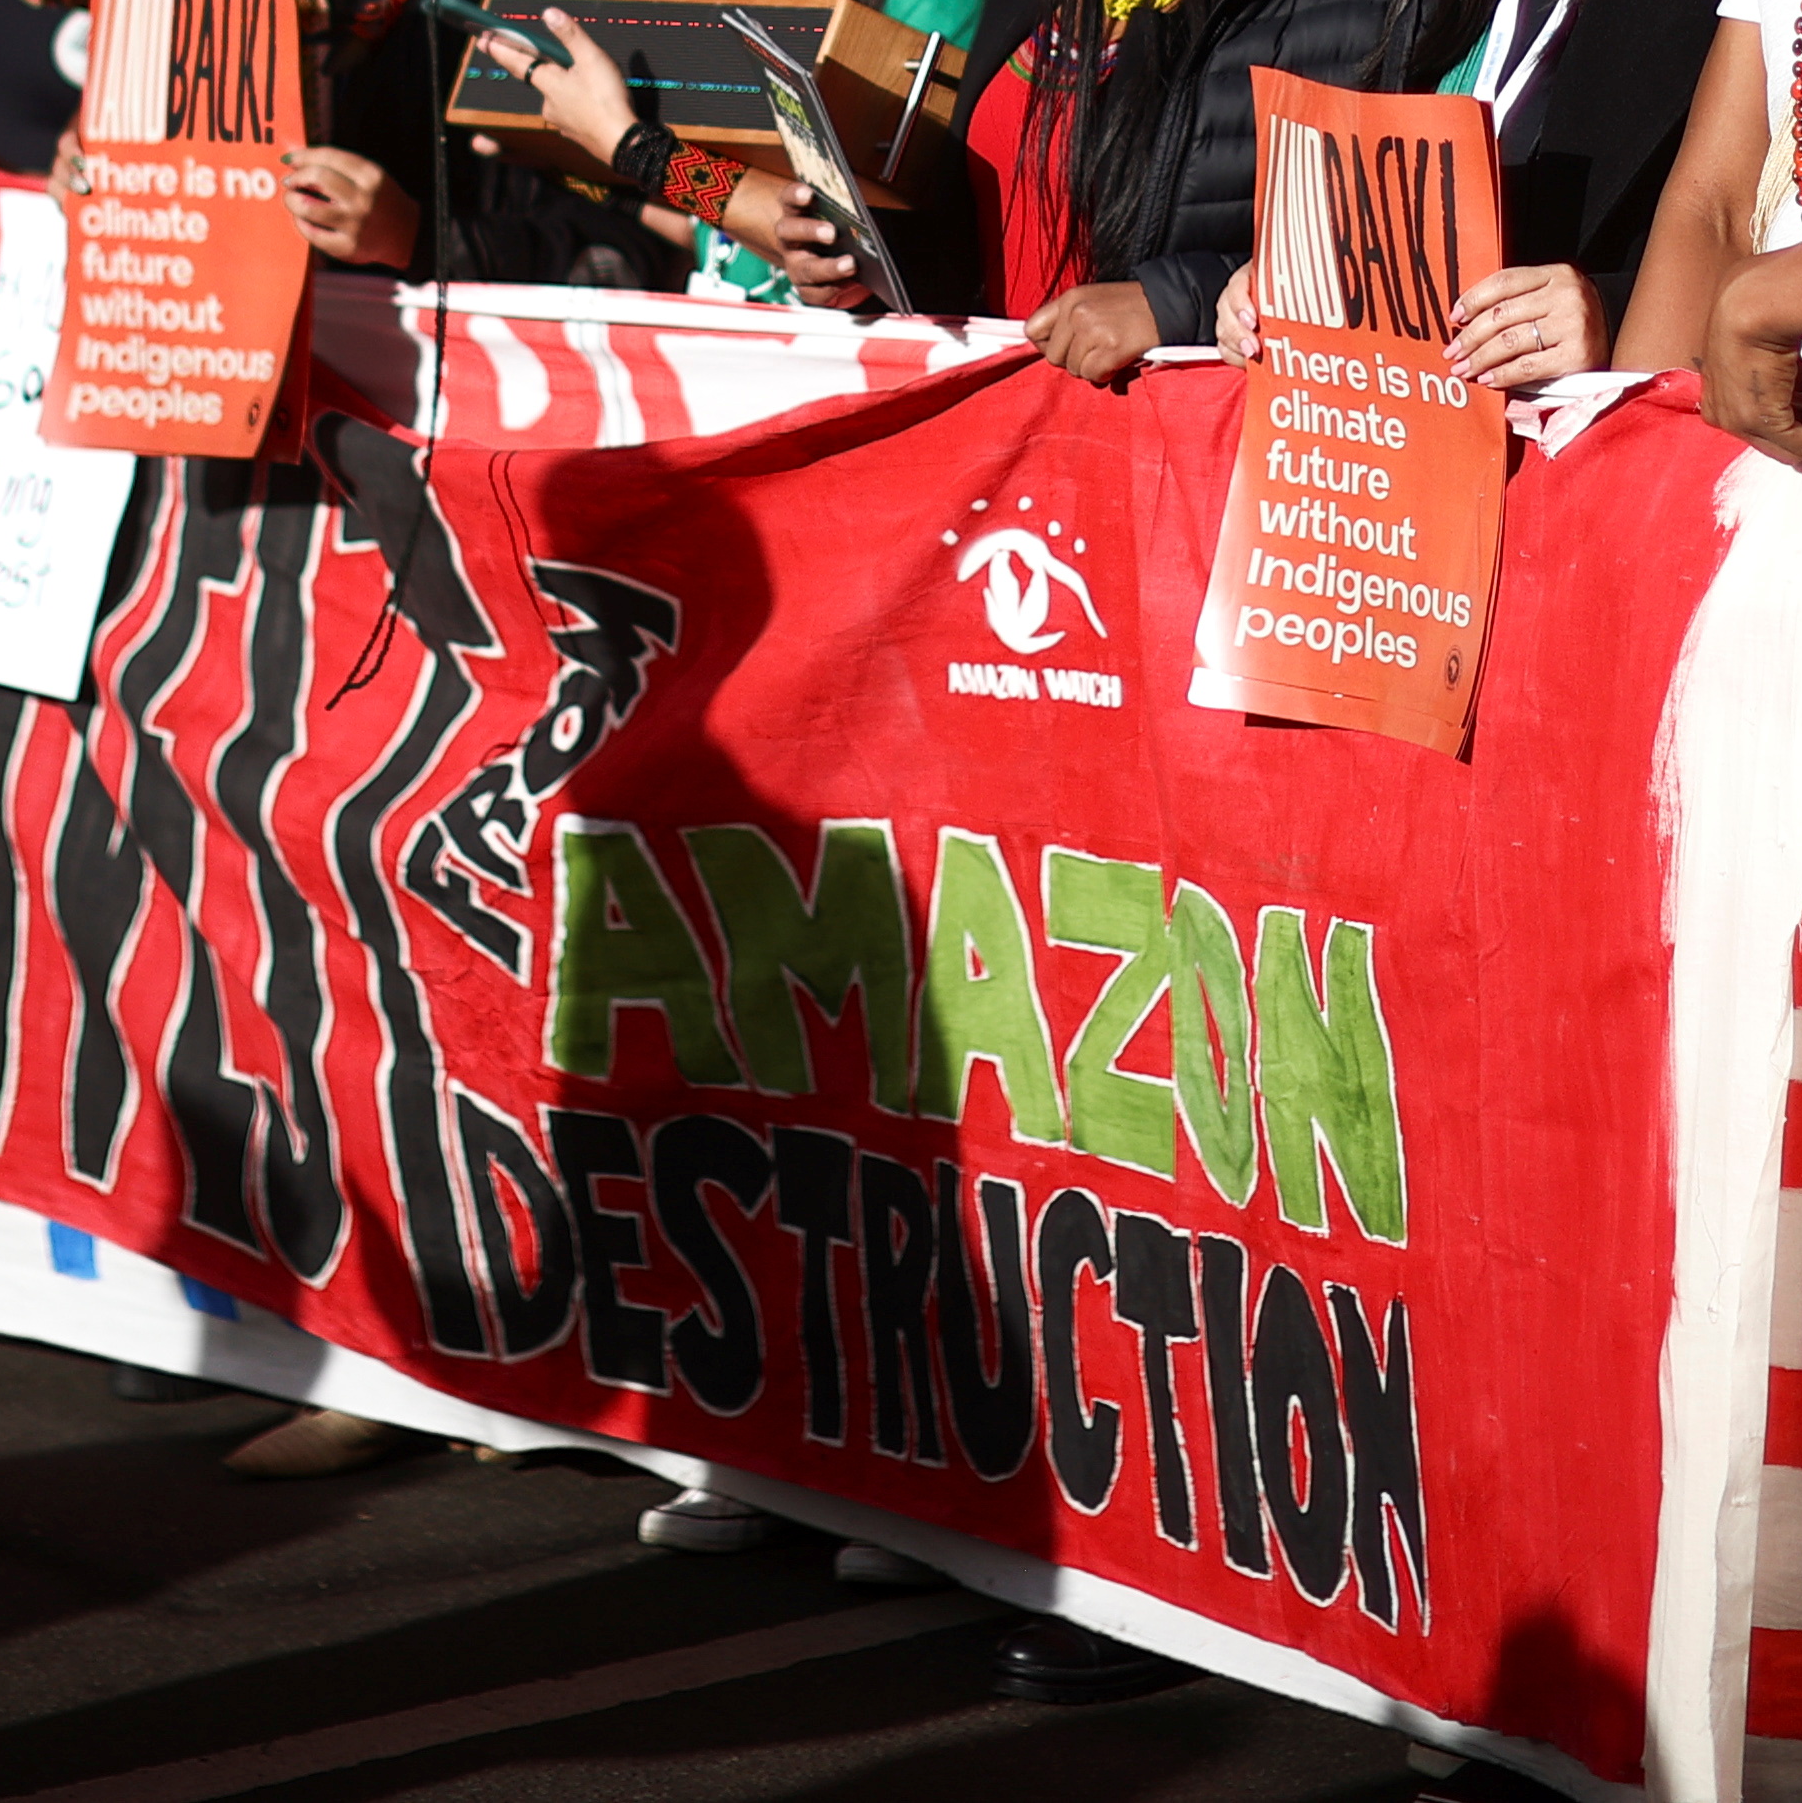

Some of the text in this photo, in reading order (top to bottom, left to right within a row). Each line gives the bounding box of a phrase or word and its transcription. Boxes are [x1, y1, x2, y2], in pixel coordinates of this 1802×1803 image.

[83, 153, 278, 202] There is no
[78, 198, 210, 246] climate
[79, 240, 195, 288] future
[80, 290, 225, 336] without
[75, 332, 276, 385] Indigenous
[1264, 337, 1469, 410] There is no
[65, 382, 224, 429] peoples
[1268, 396, 1407, 451] climate
[1265, 438, 1391, 501] future
[1259, 499, 1418, 562] without
[1246, 547, 1472, 629] Indigenous
[1233, 605, 1418, 670] peoples
[948, 662, 1122, 708] AMAZON WATCH
[399, 557, 680, 987] FROM
[543, 815, 1408, 1248] AMAZON
[445, 1078, 1433, 1638] DESTRUCTION
